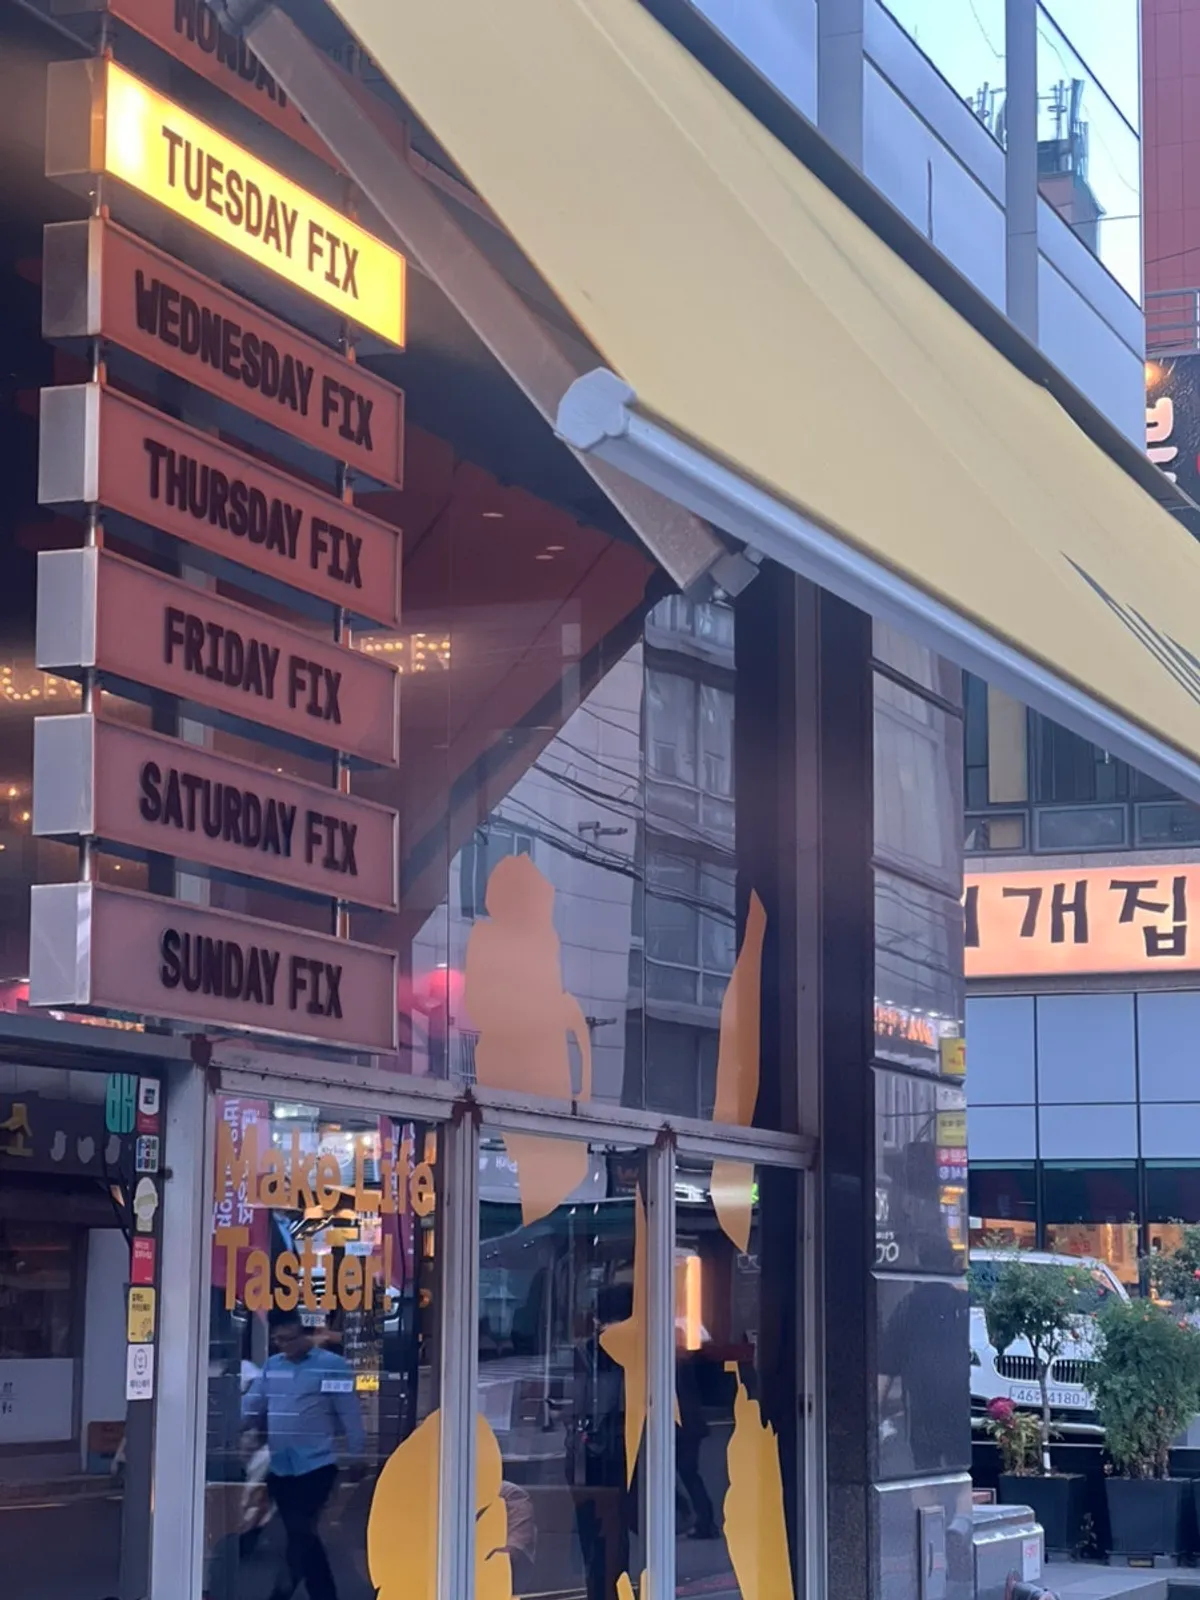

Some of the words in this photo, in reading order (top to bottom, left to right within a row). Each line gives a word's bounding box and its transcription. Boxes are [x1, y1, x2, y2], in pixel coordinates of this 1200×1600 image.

[161, 125, 299, 260] TUESDAY
[307, 219, 360, 300] FIX
[135, 269, 315, 417] WEDNESDAY
[322, 375, 374, 452] FIX
[144, 438, 303, 561] THURSDAY
[311, 515, 363, 589] FIX
[164, 606, 280, 700] FRIDAY
[288, 654, 342, 724] FIX
[140, 761, 297, 858] SATURDAY
[305, 810, 358, 876] FIX
[160, 928, 280, 1006] SUNDAY
[289, 955, 343, 1019] FIX
[215, 1120, 343, 1211] Make
[354, 1135, 436, 1218] Life
[214, 1227, 393, 1313] Tastier!
